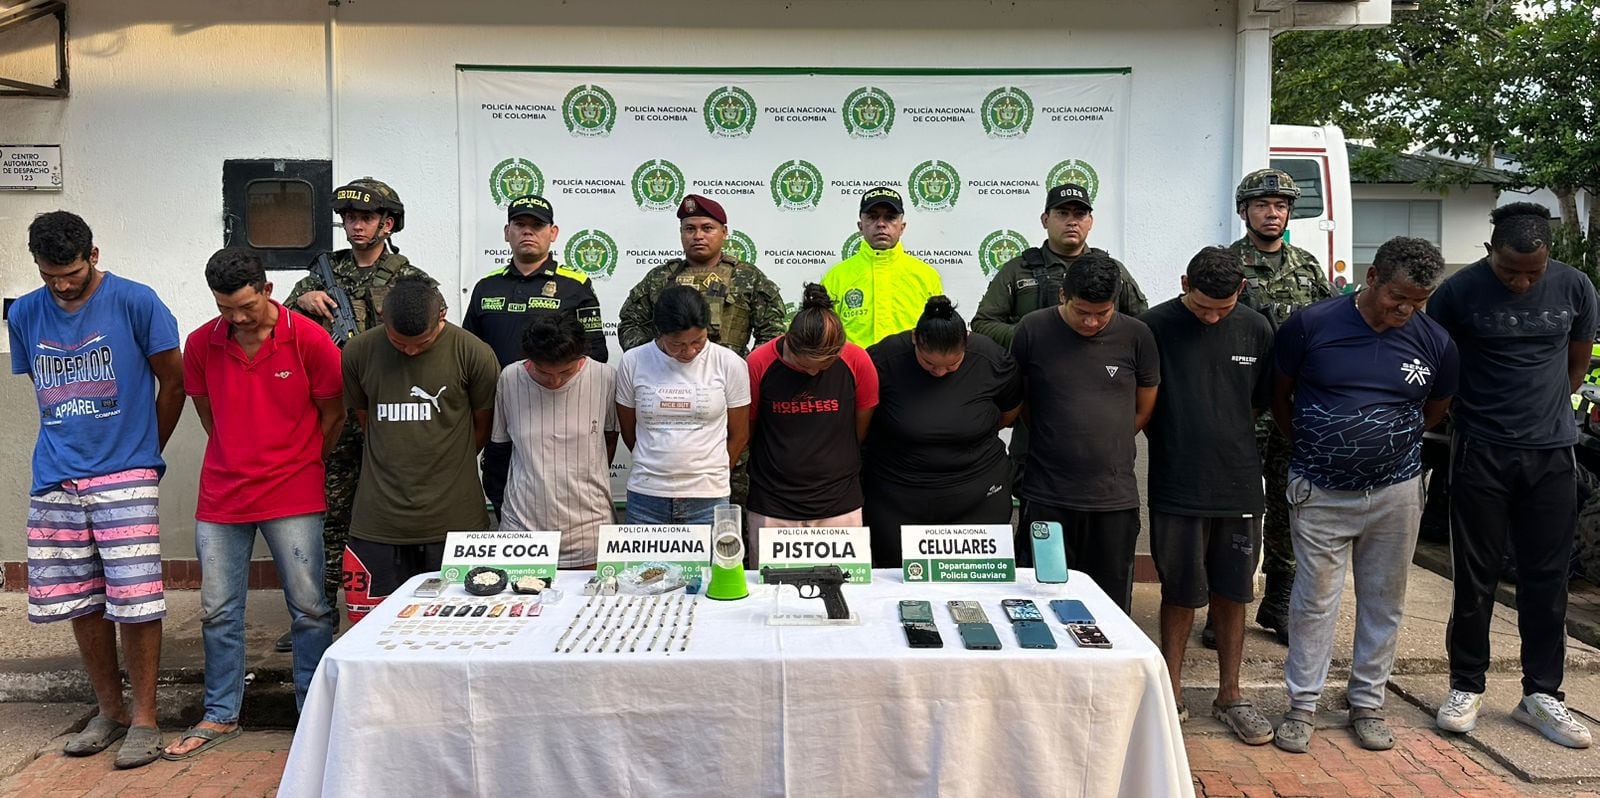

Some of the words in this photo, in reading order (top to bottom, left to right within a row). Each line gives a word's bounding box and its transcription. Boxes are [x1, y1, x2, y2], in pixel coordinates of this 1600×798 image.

[514, 103, 556, 112] NACIONAL
[658, 105, 698, 113] NACIONAL
[1073, 106, 1114, 114] NACIONAL
[364, 193, 371, 202] 6
[34, 345, 116, 391] SUPERIOR
[1402, 362, 1430, 372] SENA
[55, 399, 99, 418] APPAREL
[95, 410, 121, 419] COMPANY
[377, 403, 431, 421] PUMA
[454, 545, 497, 558] BASE
[502, 544, 549, 557] COCA
[606, 540, 704, 554] MARIHUANA
[773, 542, 856, 558] PISTOLA
[919, 539, 997, 554] CELULARES
[938, 562, 996, 570] Departamento
[343, 571, 368, 592] 23
